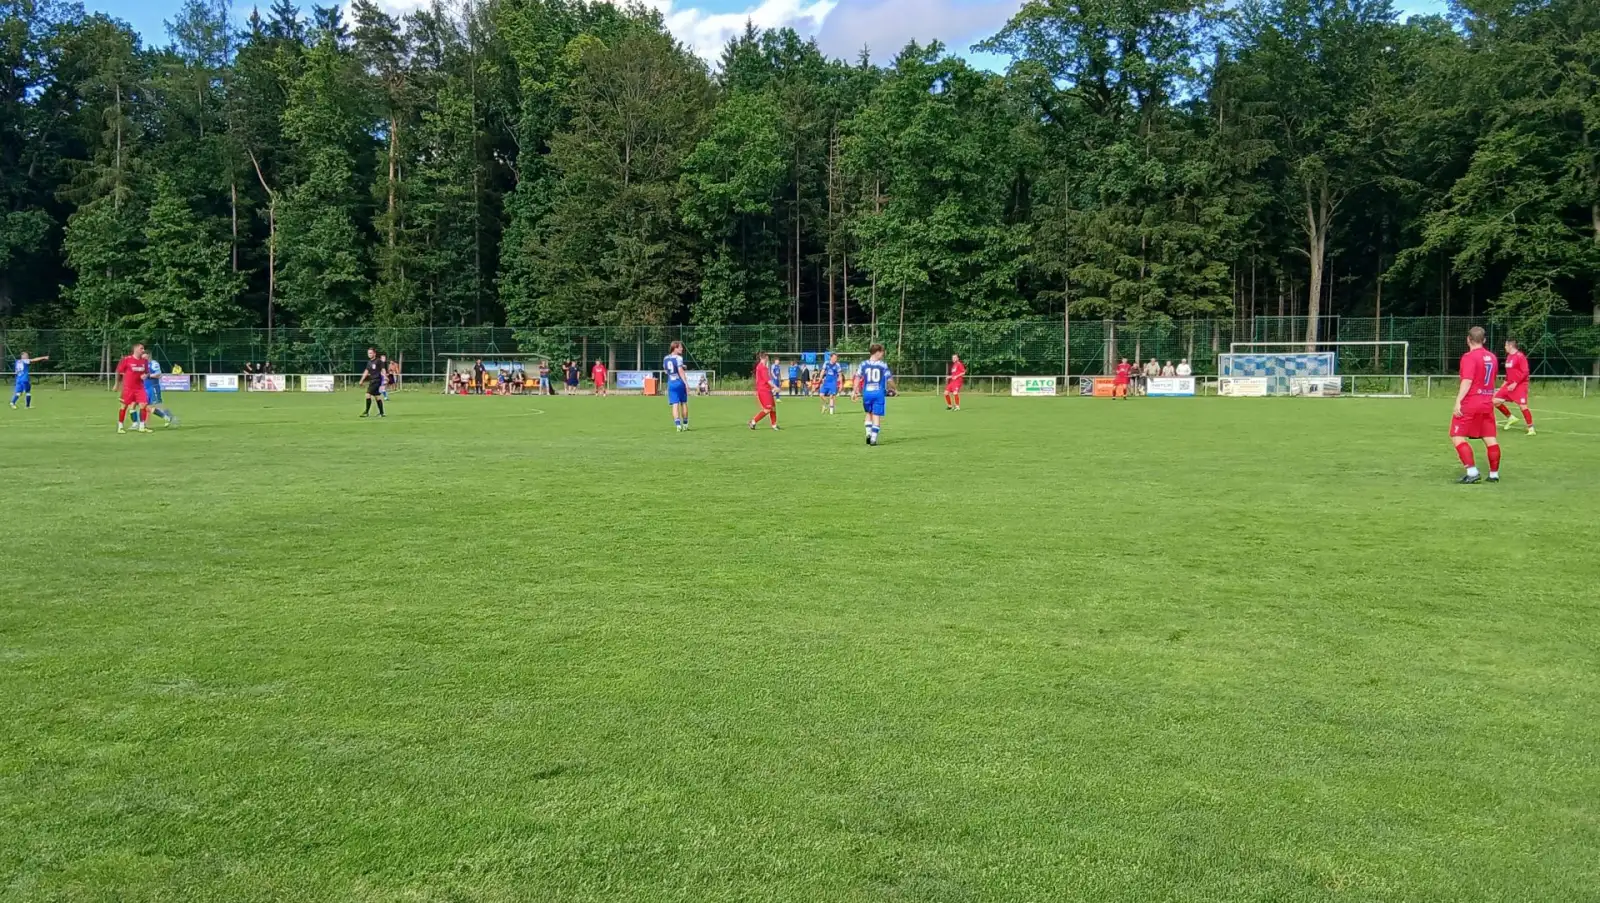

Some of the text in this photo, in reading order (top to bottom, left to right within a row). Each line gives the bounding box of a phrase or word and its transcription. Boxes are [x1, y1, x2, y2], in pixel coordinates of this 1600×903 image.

[667, 360, 674, 373] 9
[866, 368, 881, 382] 10
[1484, 362, 1493, 386] 7
